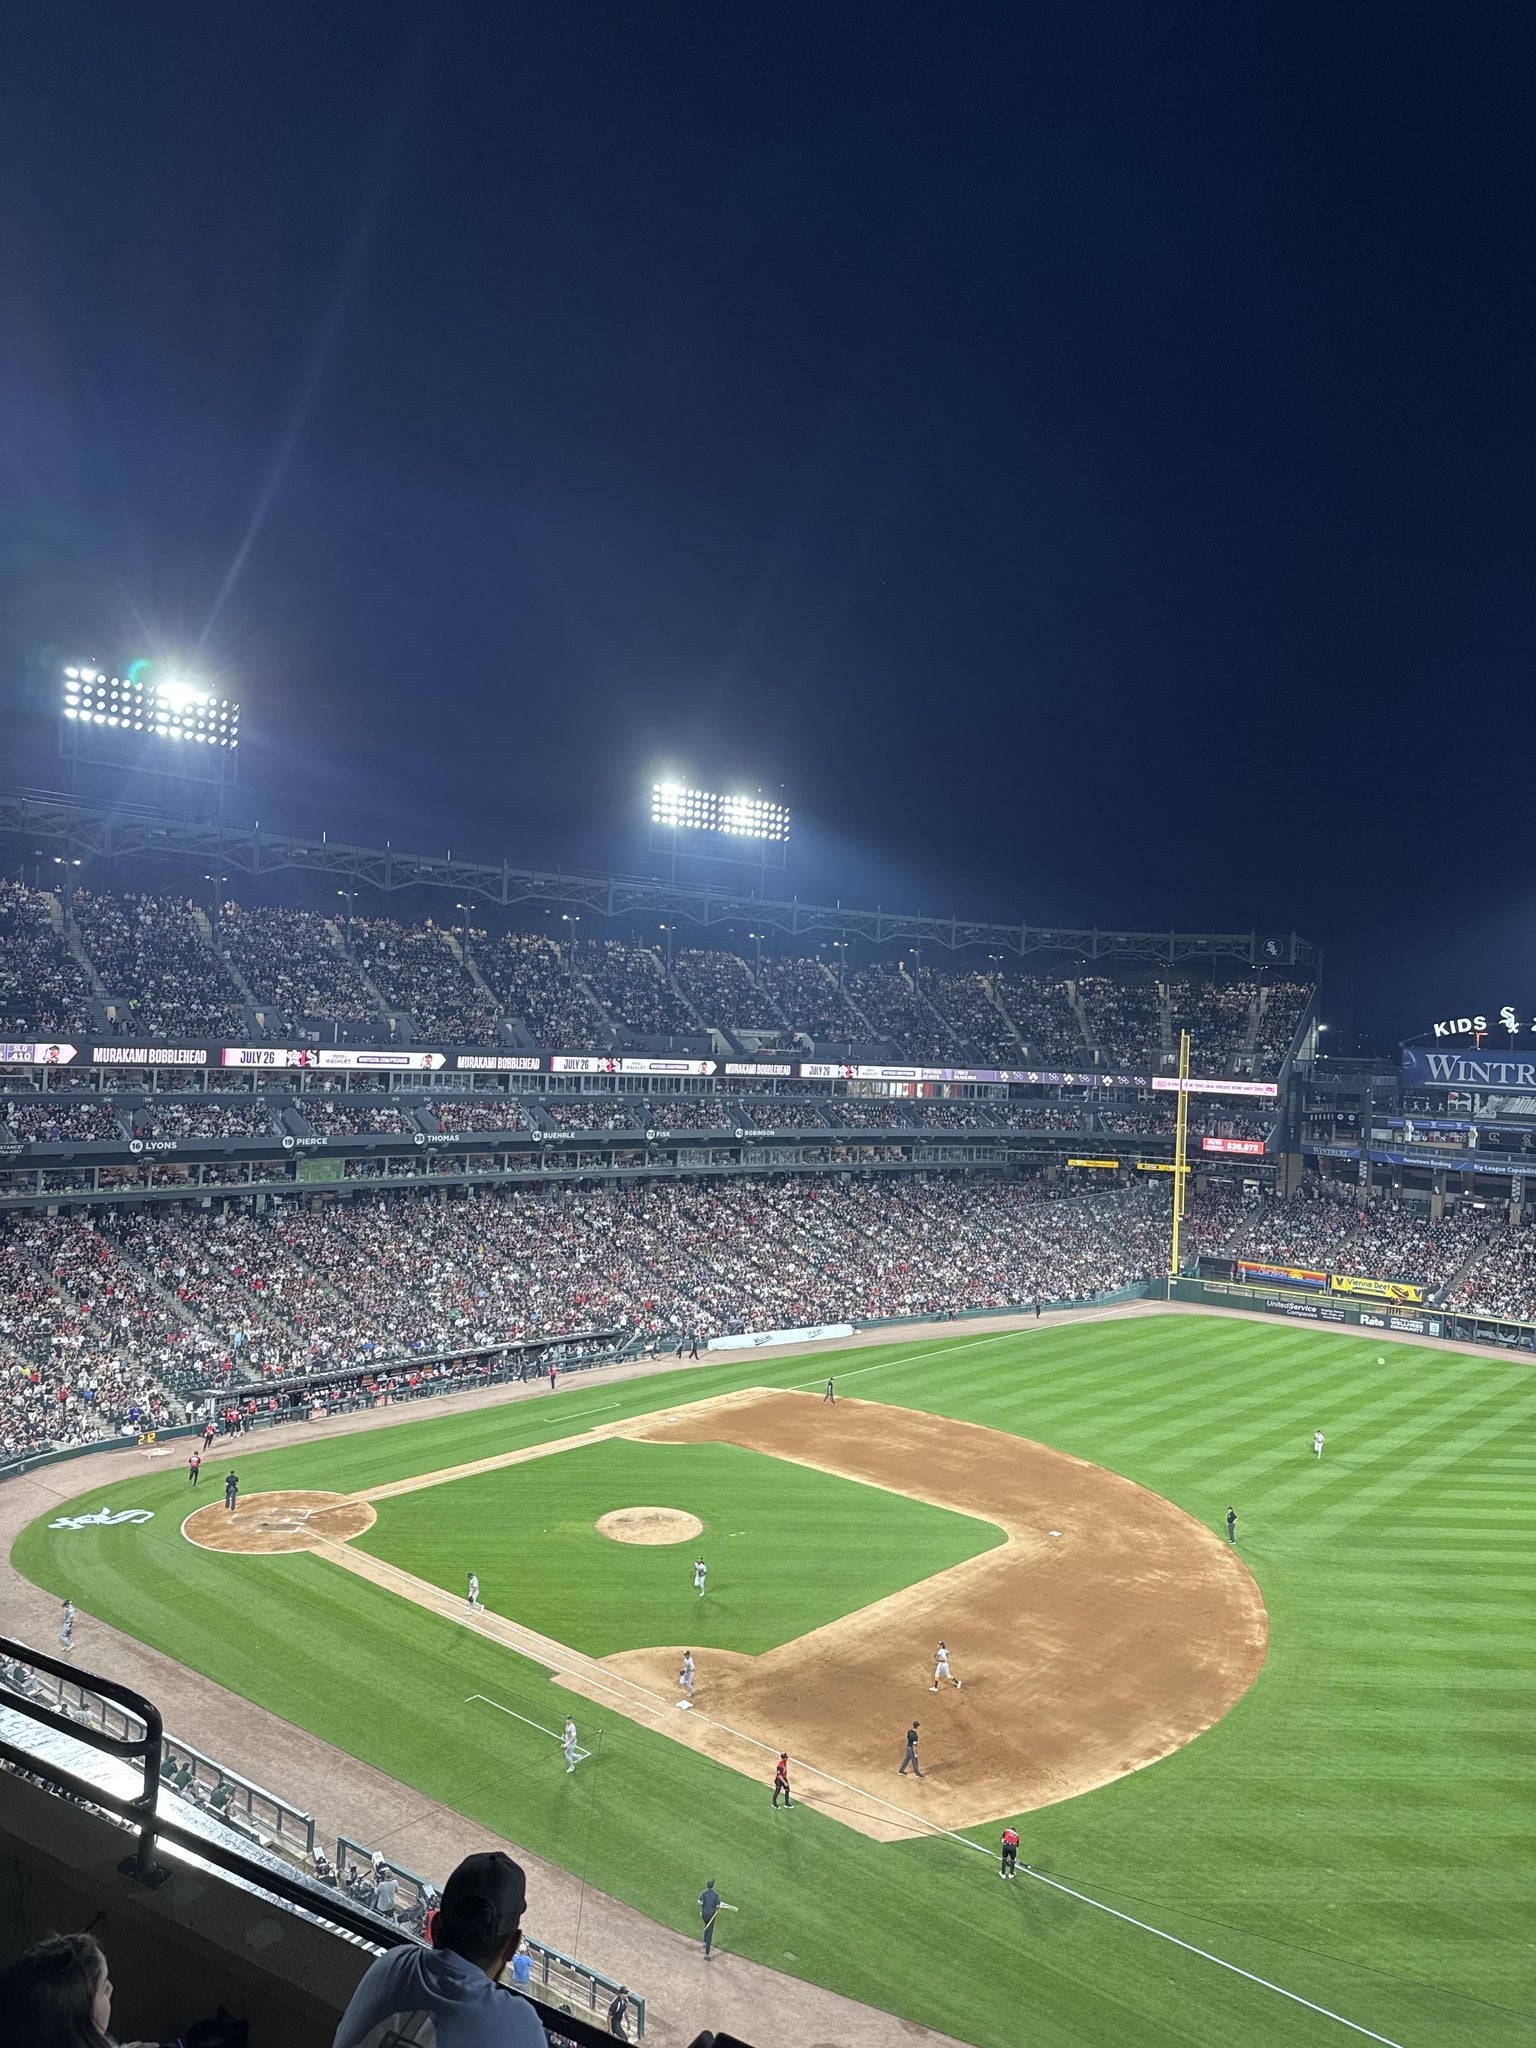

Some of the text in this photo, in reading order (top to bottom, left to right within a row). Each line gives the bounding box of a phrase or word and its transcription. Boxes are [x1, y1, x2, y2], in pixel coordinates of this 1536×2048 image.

[1433, 1016, 1487, 1037] KIDS
[13, 1044, 28, 1052] SLG
[9, 1052, 31, 1060] .410
[93, 1047, 207, 1065] MURAKAMI BOBBLEHEAD
[240, 1051, 275, 1065] JULY 26
[457, 1056, 540, 1070] MURAKAMI BOBBLEHEAD
[563, 1058, 589, 1070] JULY 26
[725, 1063, 791, 1076] MURAKAMI BOBBLEHEAD
[808, 1066, 831, 1076] JULY 26
[1425, 1054, 1536, 1086] WINTR
[284, 1138, 328, 1146] 19 PIERCE
[427, 1134, 460, 1142] THOMAS
[132, 1141, 178, 1150] 16 LYONS
[1313, 1146, 1348, 1156] WINTRUST
[1403, 1158, 1452, 1169] Hometown Banking
[1474, 1164, 1506, 1173] Big-League
[1348, 1278, 1373, 1288] Vienna
[1374, 1281, 1390, 1290] Beef
[1286, 1309, 1318, 1318] Companies
[1360, 1314, 1385, 1327] Rate
[1390, 1320, 1424, 1329] WELLNESS
[1390, 1324, 1424, 1333] COMMUNITY
